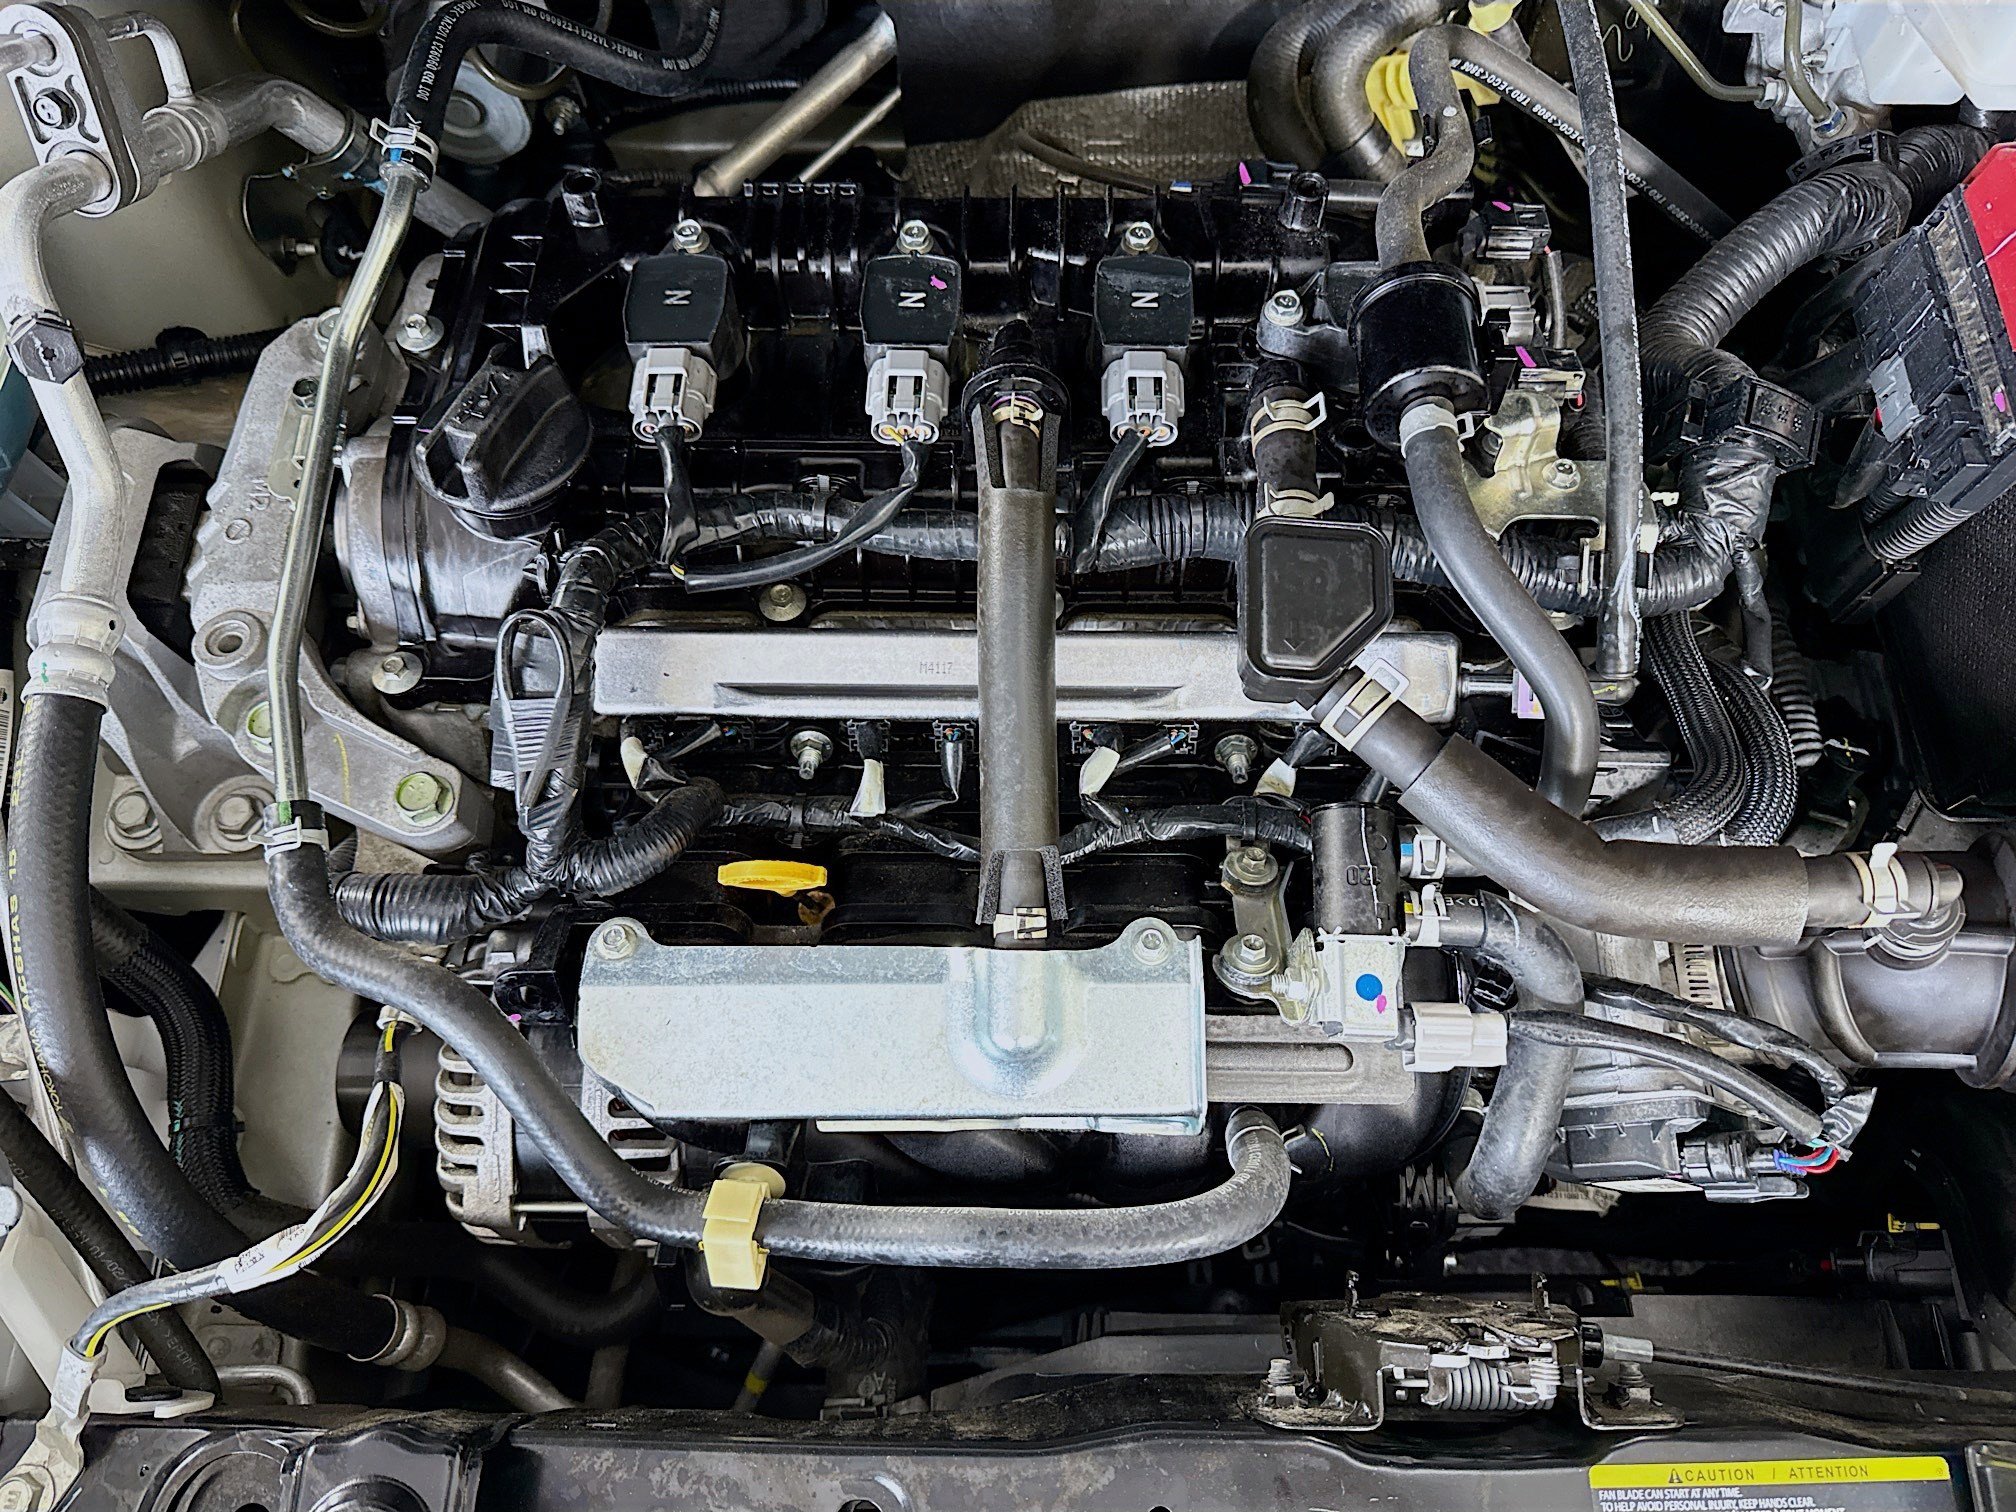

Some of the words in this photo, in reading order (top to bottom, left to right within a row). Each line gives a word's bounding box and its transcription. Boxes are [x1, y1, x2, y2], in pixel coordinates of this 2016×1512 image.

[416, 85, 431, 101] DOT
[919, 661, 953, 675] M4117
[29, 1028, 64, 1111] YOKOHAMA
[1685, 1468, 1755, 1482] CAUTION
[1789, 1465, 1869, 1479] ATTENTION
[1598, 1490, 1616, 1500] FAN
[1616, 1489, 1644, 1500] BLADE
[1644, 1489, 1664, 1499] CAN
[1664, 1488, 1690, 1499] START
[1690, 1488, 1702, 1499] AT
[1702, 1487, 1720, 1498] ANY
[1600, 1501, 1614, 1512] TO
[1615, 1501, 1637, 1512] HELP
[1637, 1501, 1664, 1512] AVOID
[1665, 1500, 1708, 1511] PERSONAL
[1738, 1498, 1759, 1509] KEEP
[1759, 1497, 1787, 1508] HANDS
